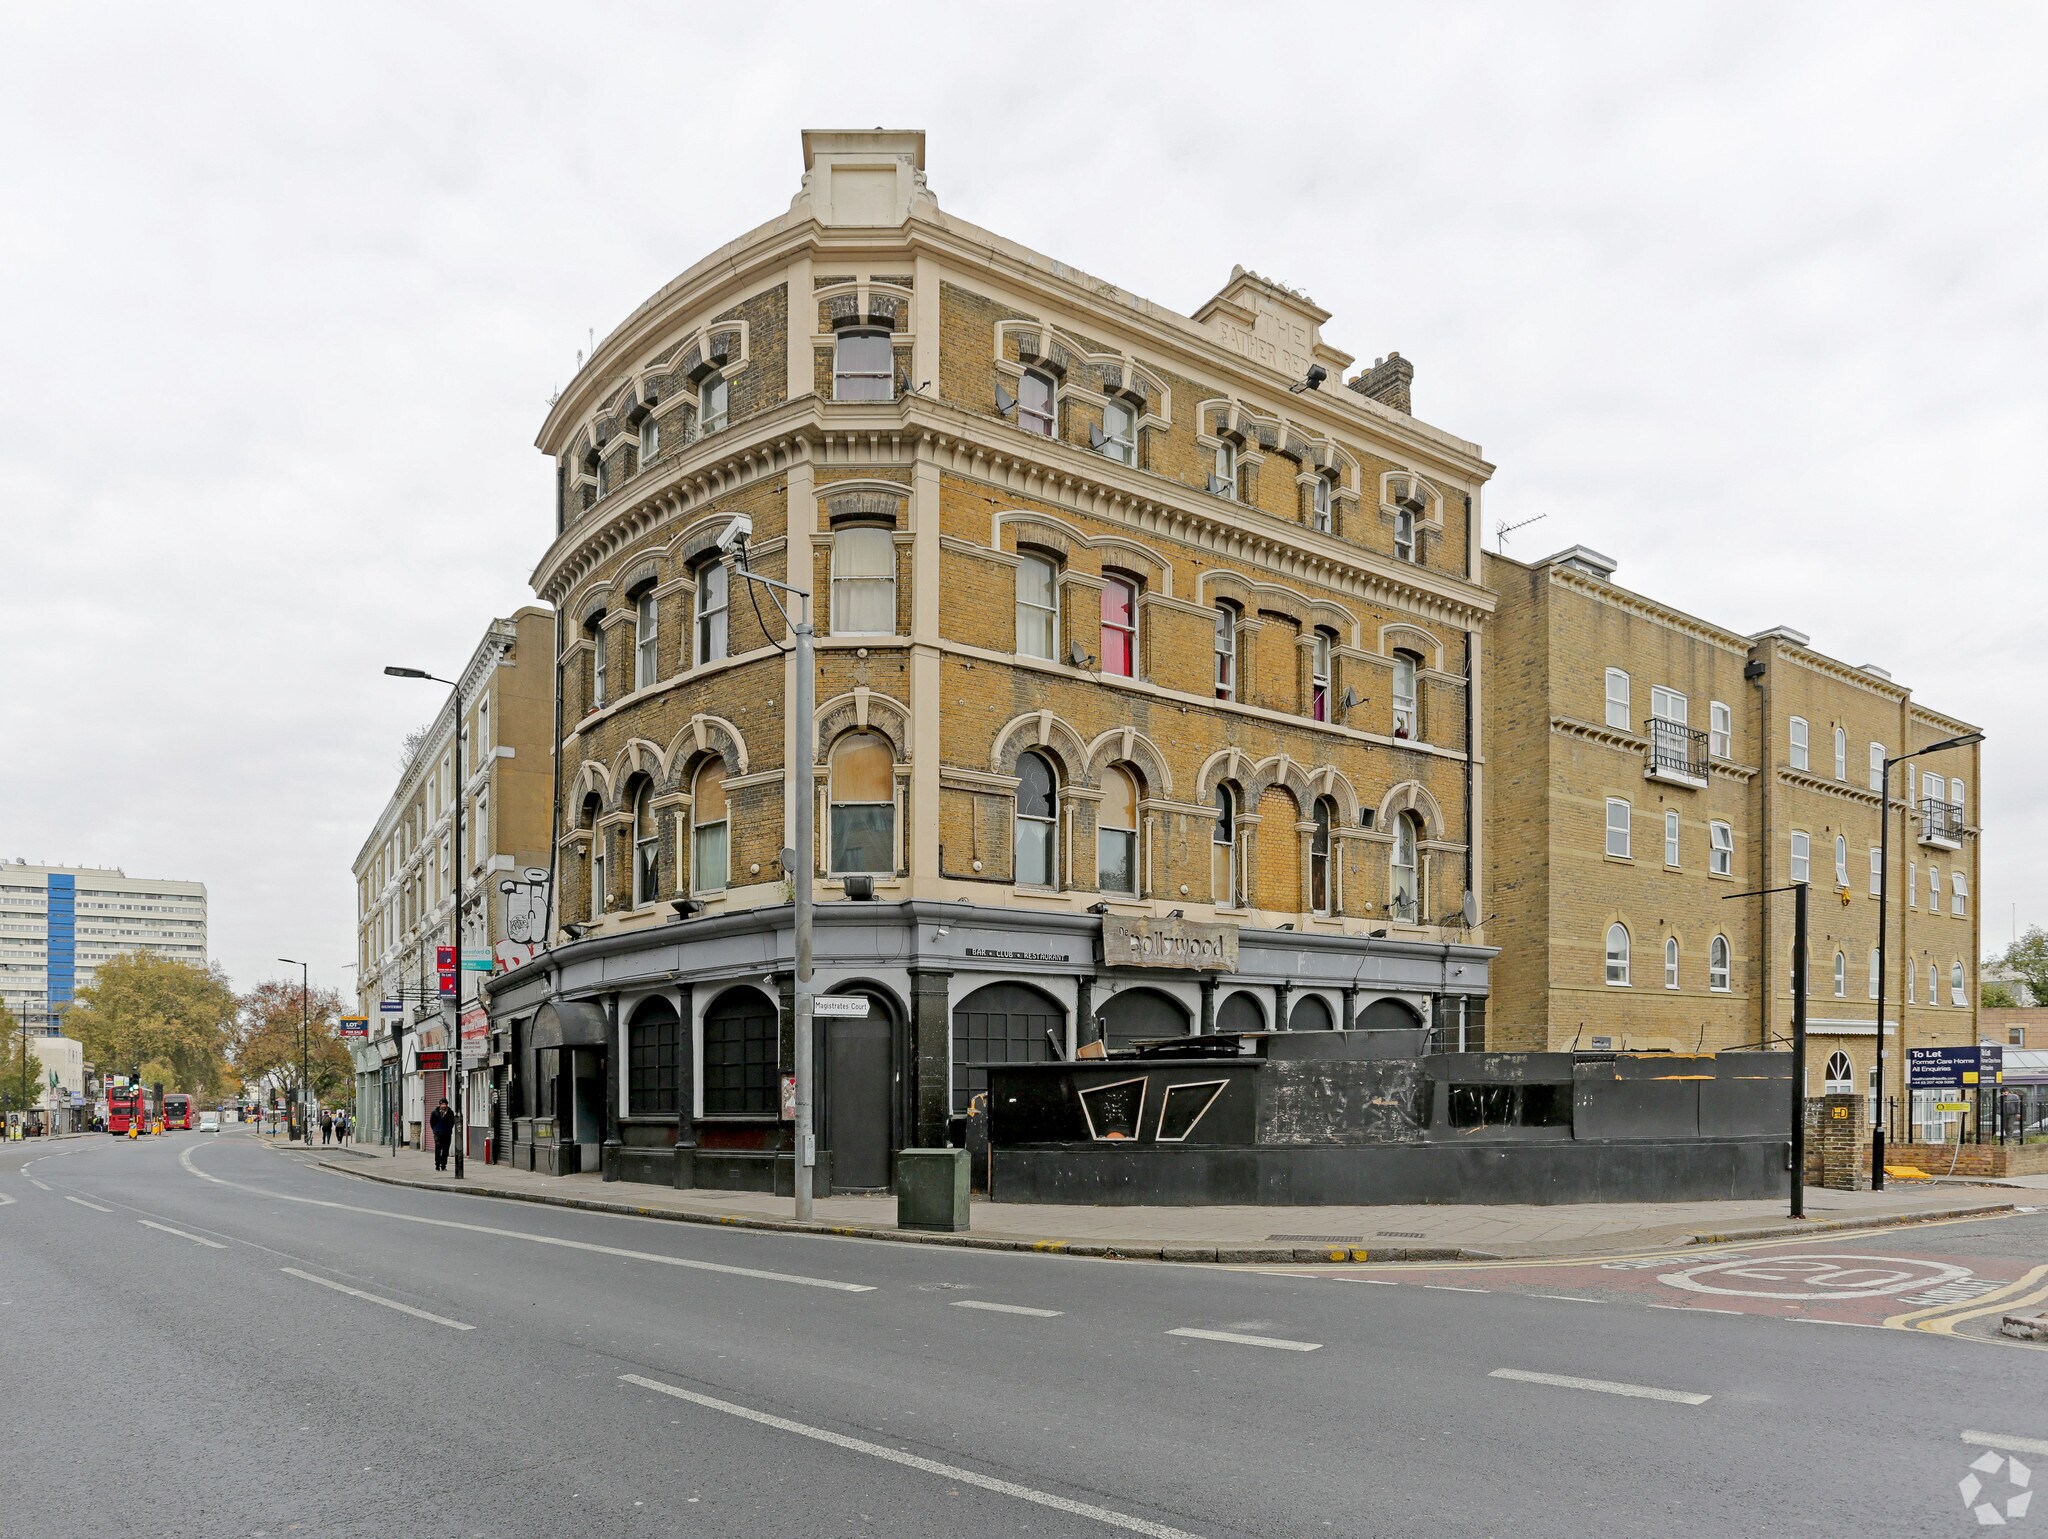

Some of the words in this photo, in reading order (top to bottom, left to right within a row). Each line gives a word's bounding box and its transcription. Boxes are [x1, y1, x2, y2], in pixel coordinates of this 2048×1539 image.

[1259, 309, 1306, 350] THE
[1282, 349, 1342, 392] REDAP
[972, 948, 986, 956] BAR
[996, 949, 1014, 958] CLUB
[1023, 951, 1065, 962] RESTAURANT
[815, 1001, 849, 1011] Magistrates
[850, 1002, 867, 1010] Court
[1912, 1050, 1924, 1058] To
[1926, 1050, 1942, 1058] Let
[1921, 1065, 1951, 1073] Enquiries
[1720, 1261, 1914, 1288] 20
